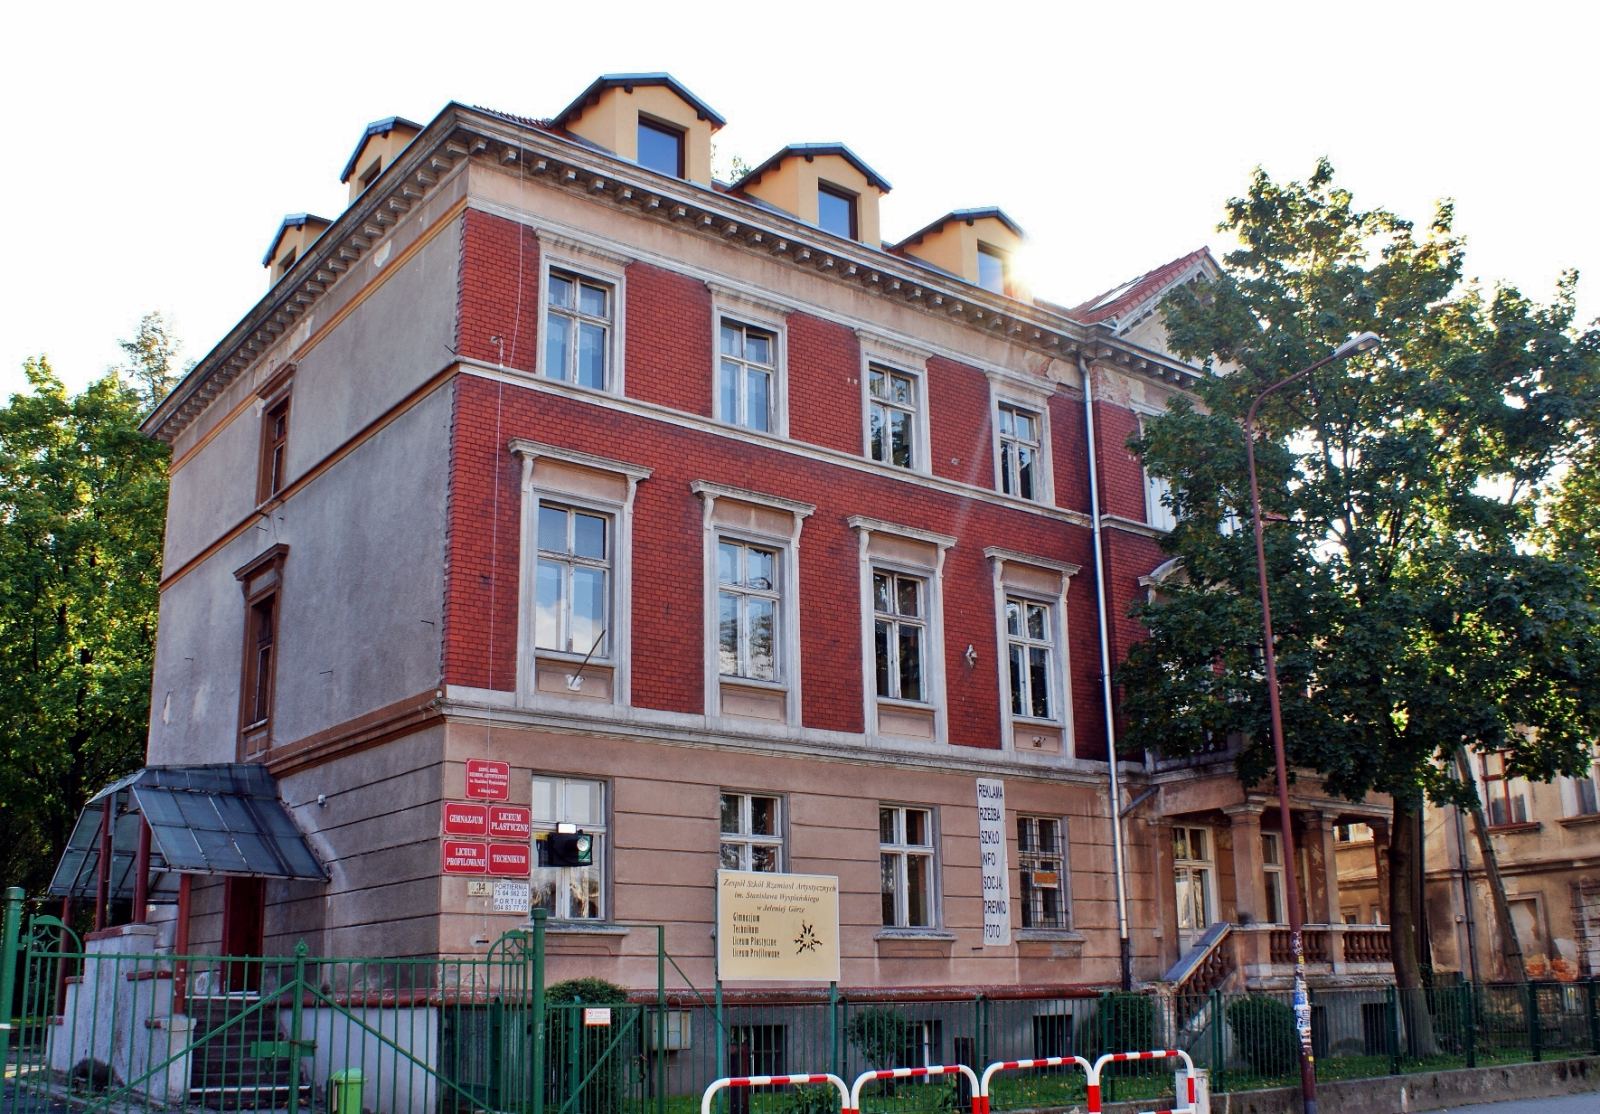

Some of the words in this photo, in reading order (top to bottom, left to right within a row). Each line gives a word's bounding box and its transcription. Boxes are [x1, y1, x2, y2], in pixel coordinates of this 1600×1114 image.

[978, 784, 1003, 799] REKLAMA
[449, 814, 483, 824] GIMNAZJUM
[499, 812, 521, 822] LICEUM
[491, 822, 529, 832] PLASTYCZNE
[455, 848, 477, 857] LICEUM
[446, 857, 486, 867] PROFILOWANE
[492, 854, 526, 864] TECHNIKUM
[985, 924, 1001, 938] FOTO
